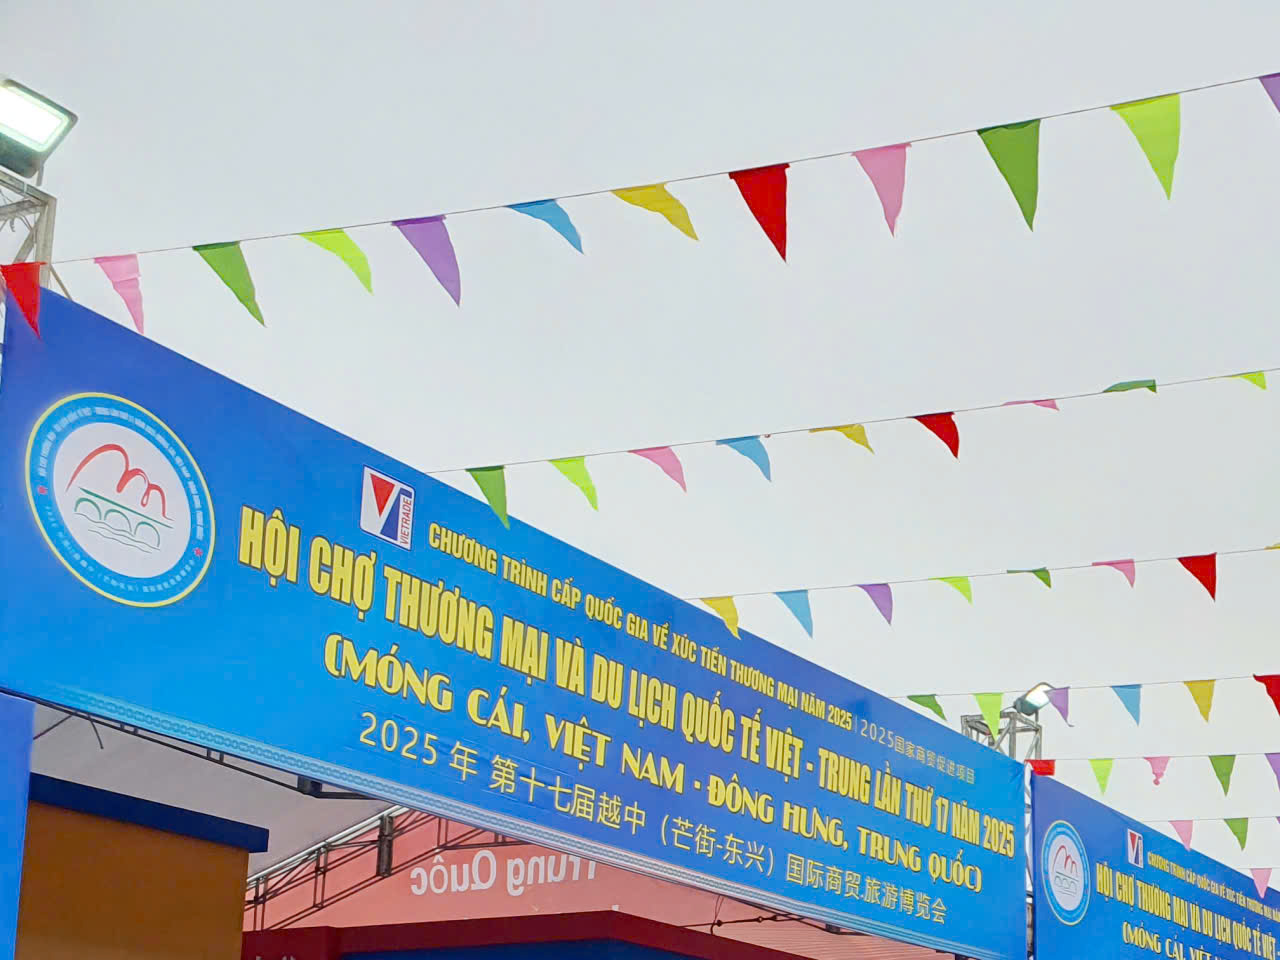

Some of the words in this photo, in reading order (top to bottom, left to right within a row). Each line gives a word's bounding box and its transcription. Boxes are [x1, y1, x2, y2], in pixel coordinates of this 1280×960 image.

[400, 497, 412, 545] VIETRADE
[238, 505, 300, 587] HỘI
[309, 536, 377, 620] CHỢ
[383, 565, 494, 660] THƯƠNG
[500, 615, 549, 685] MẠI
[555, 637, 585, 696] VÀ
[591, 654, 624, 709] DU
[628, 669, 677, 728] LỊCH
[681, 690, 736, 753] QUỐC
[740, 708, 762, 764] TẾ
[765, 724, 804, 783] VIỆT
[818, 748, 872, 805] TRUNG
[874, 766, 902, 816] LẦN
[905, 783, 934, 828] THỨ
[935, 796, 950, 833] 17
[952, 800, 981, 846] NĂM
[983, 815, 1015, 858] 2025
[429, 521, 498, 573] CHƯƠNG
[502, 555, 548, 597] TRÌNH
[551, 578, 582, 609] CẤP
[585, 594, 623, 630] QUỐC
[626, 612, 649, 641] GIA
[652, 621, 669, 651] VỀ
[671, 632, 698, 663] XÚC
[700, 645, 727, 677] TIẾN
[730, 660, 775, 698] THƯƠNG
[777, 682, 799, 709] MẠI
[801, 691, 826, 721] NĂM
[828, 704, 853, 731] 2025
[324, 634, 453, 711] (MÓNG
[467, 686, 531, 743] CÁI,
[545, 714, 612, 771] VIỆT
[621, 743, 685, 794] NAM
[706, 773, 775, 824] ĐÔNG
[782, 800, 849, 850] HƯNG,
[858, 826, 922, 872] TRUNG
[928, 848, 983, 893] QUỐC)
[360, 711, 438, 766] 2025
[449, 741, 479, 781] 年
[1202, 908, 1213, 937] DU
